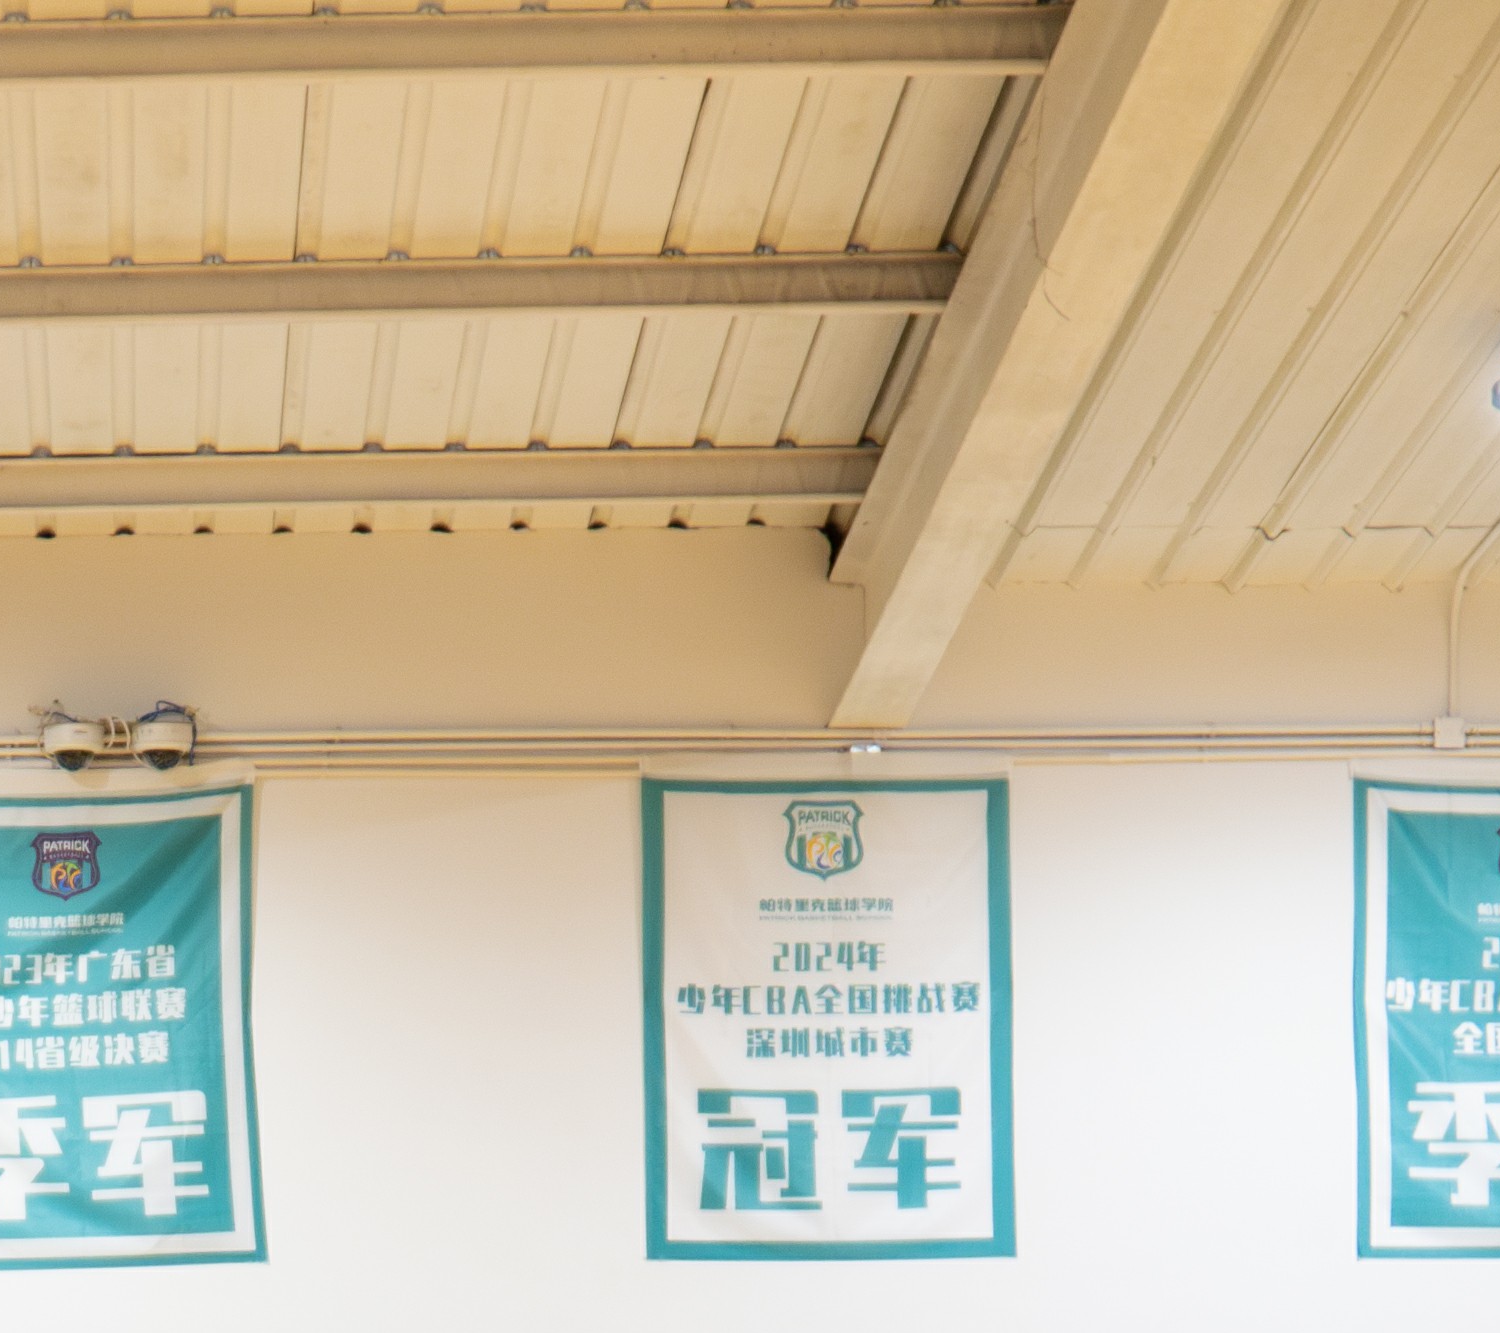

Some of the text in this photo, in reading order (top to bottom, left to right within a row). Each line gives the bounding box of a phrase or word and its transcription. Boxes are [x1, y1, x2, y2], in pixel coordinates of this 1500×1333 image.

[798, 810, 851, 825] PATRICK
[42, 840, 91, 854] PATRICK
[772, 941, 885, 972] 2024年
[677, 981, 982, 1016] 少年CBA全国挑战赛
[745, 1026, 914, 1058] 深圳城市赛
[697, 1086, 962, 1211] 冠军
